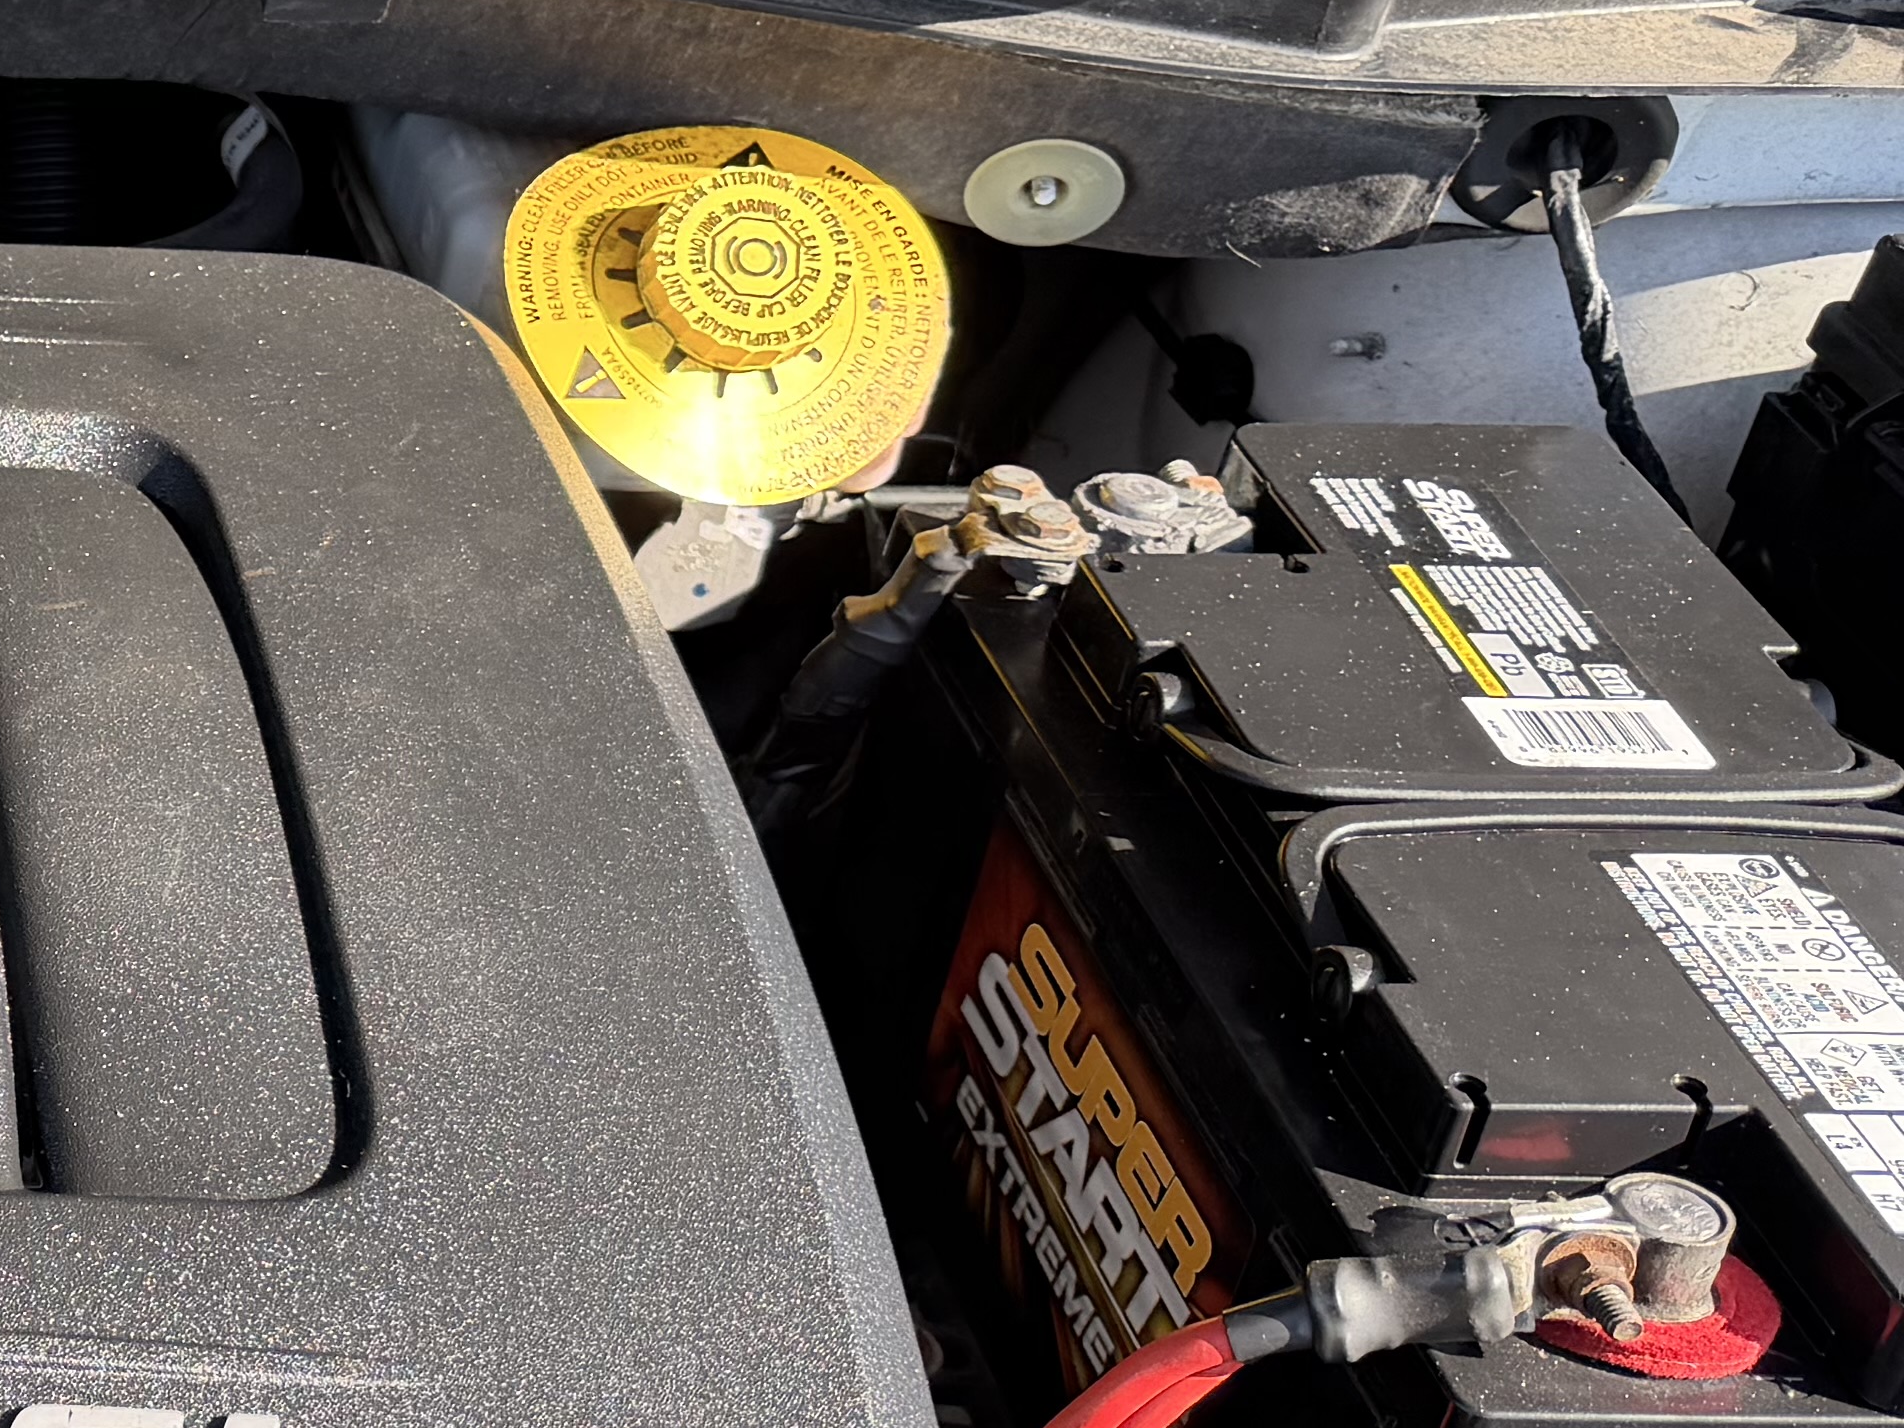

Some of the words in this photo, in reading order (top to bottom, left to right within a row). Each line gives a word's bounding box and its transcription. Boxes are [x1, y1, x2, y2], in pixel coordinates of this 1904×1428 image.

[547, 208, 573, 237] USE
[563, 181, 599, 214] ONLY
[596, 168, 628, 188] DOT
[826, 164, 874, 201] MISE
[871, 199, 897, 222] EN
[516, 236, 540, 324] WARNING:
[623, 135, 690, 159] BEFORE
[864, 219, 887, 242] DE
[1442, 488, 1512, 560] SUPER
[1488, 652, 1524, 677] Pb
[1007, 922, 1214, 1298] SUPER
[1856, 1075, 1886, 1095] GET
[960, 951, 1192, 1336] START
[955, 1073, 1118, 1376] EXTREME
[1870, 1193, 1903, 1213] H7
